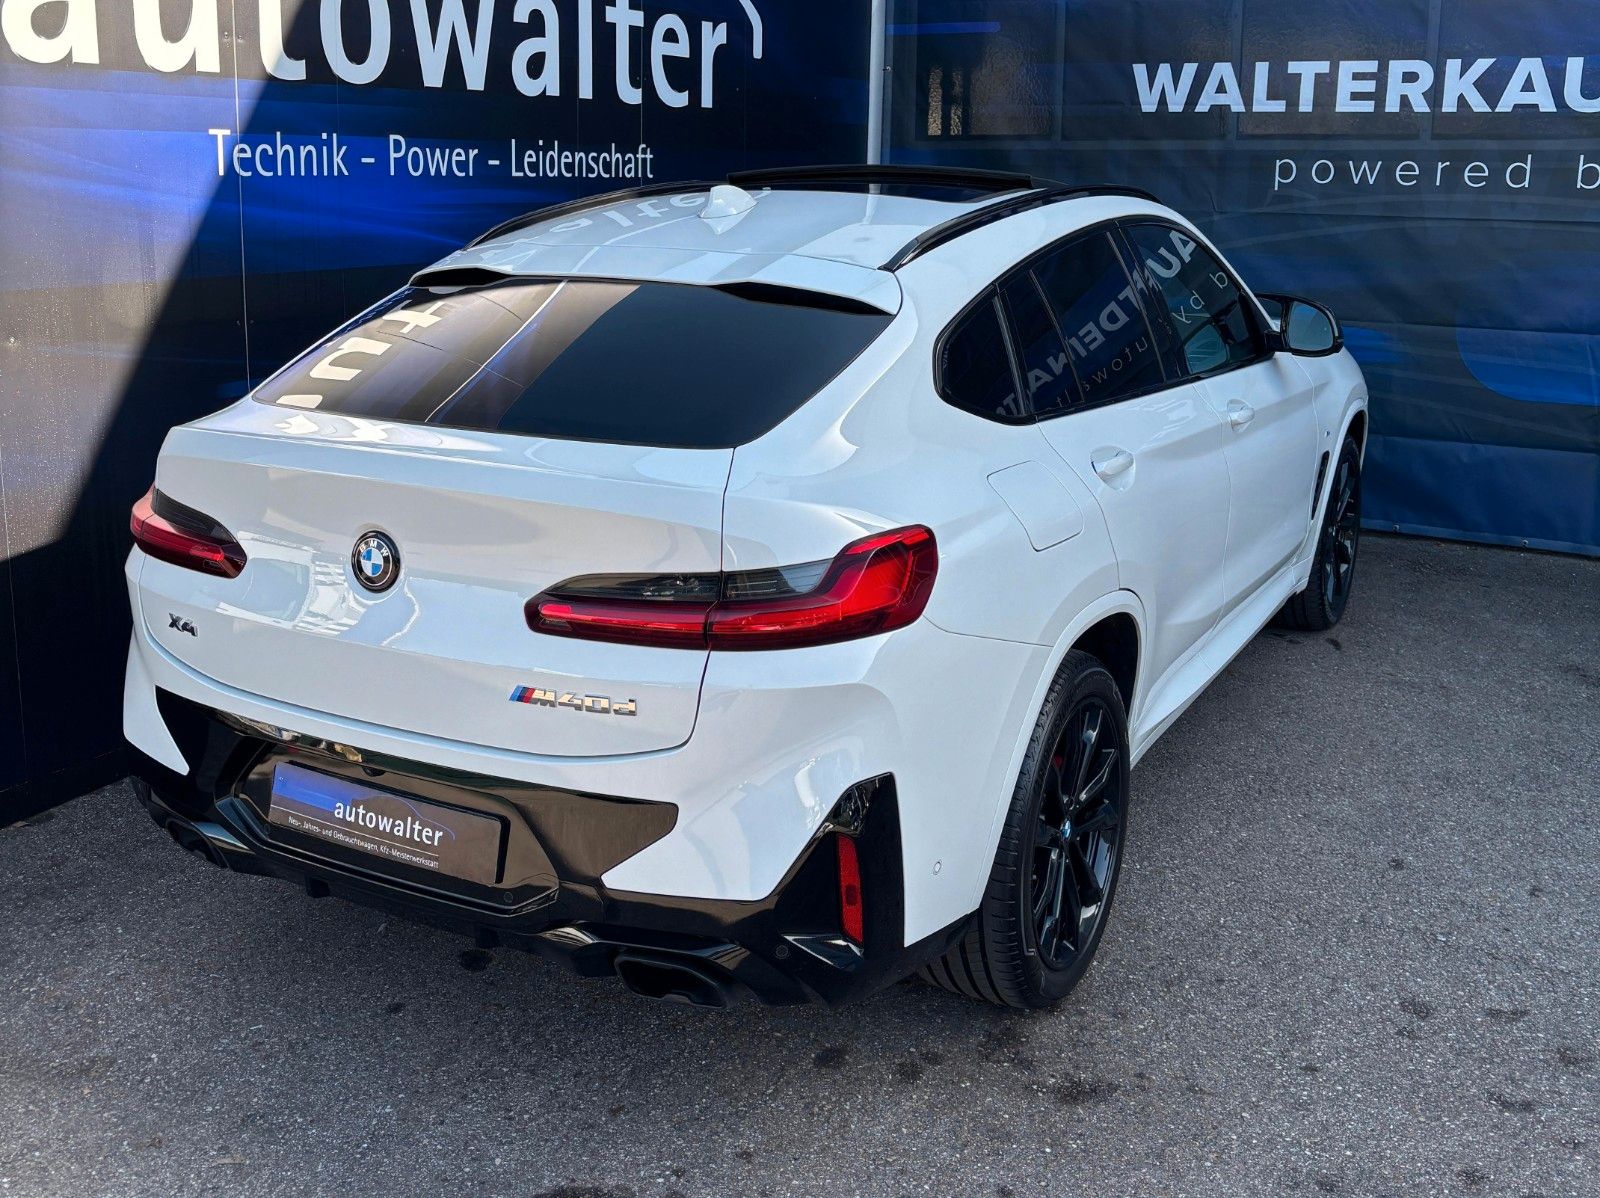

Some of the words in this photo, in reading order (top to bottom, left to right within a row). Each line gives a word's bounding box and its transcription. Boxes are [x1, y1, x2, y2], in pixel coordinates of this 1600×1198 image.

[1132, 56, 1600, 113] WALTERKAU
[208, 128, 349, 177] Technik
[389, 134, 478, 177] Power
[511, 138, 654, 179] Leidenschaft
[1274, 153, 1532, 191] powered
[360, 539, 389, 557] BMW
[168, 612, 198, 637] X4
[522, 686, 638, 716] M40d
[334, 802, 443, 846] autowalter
